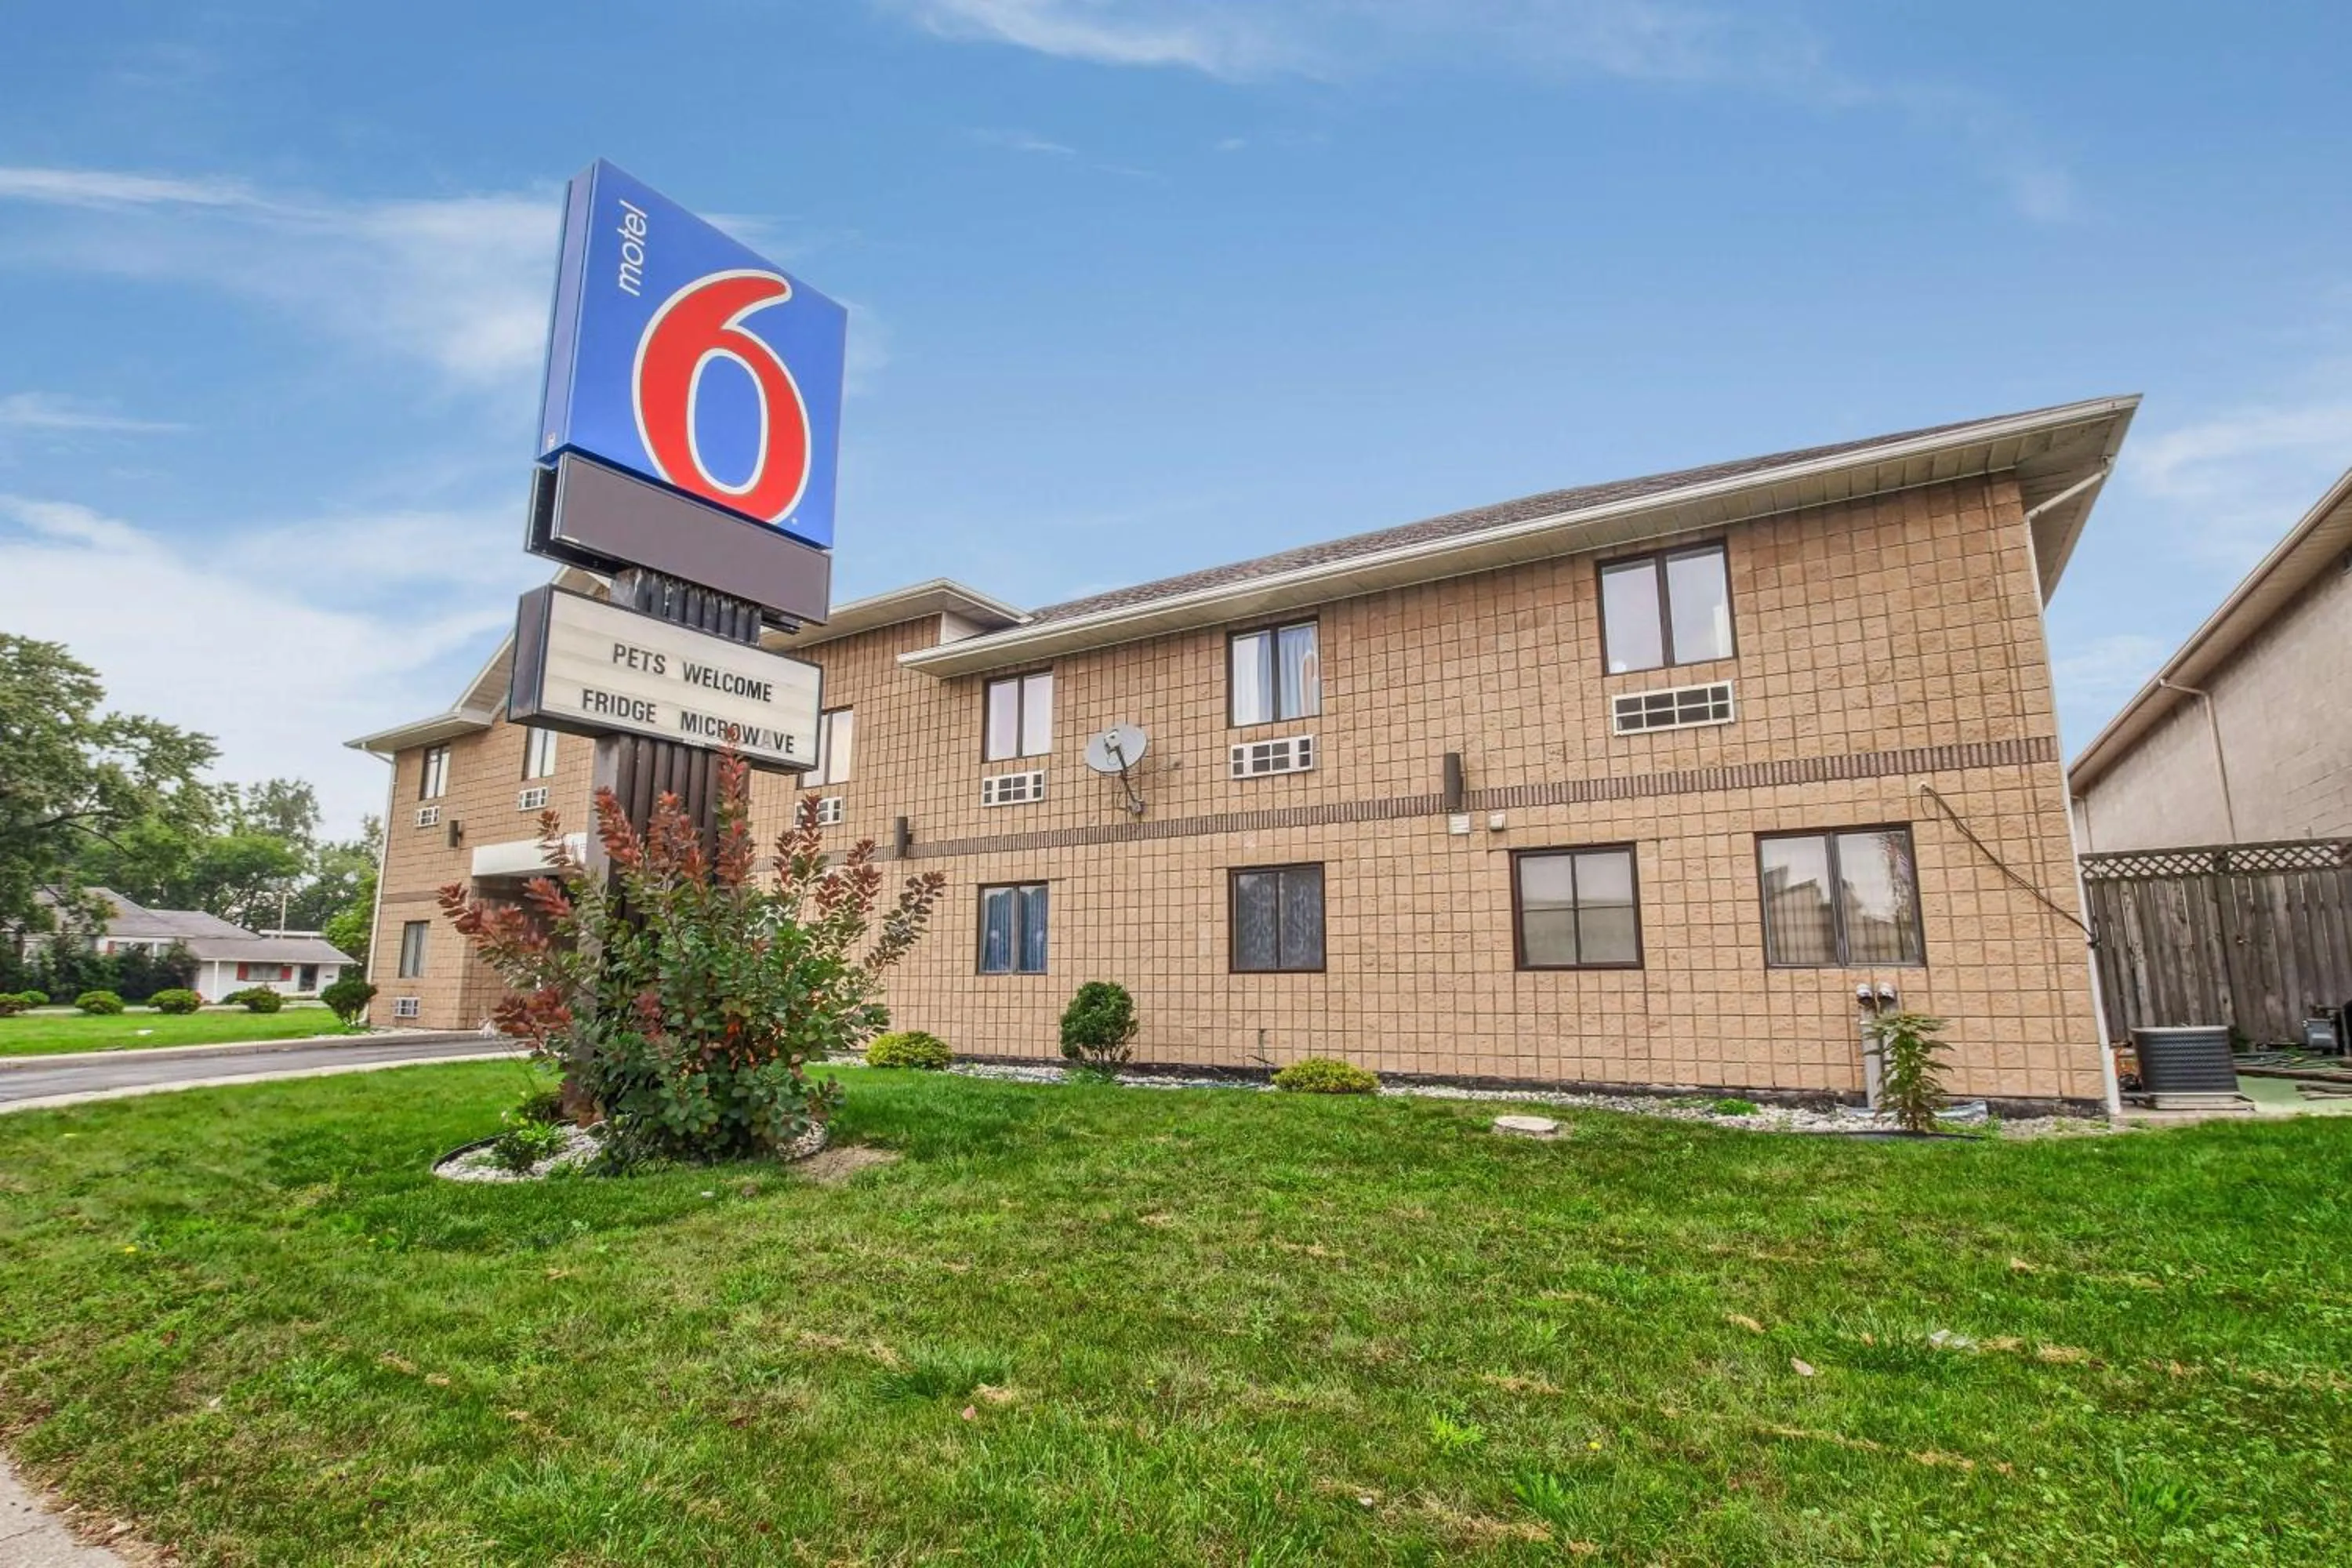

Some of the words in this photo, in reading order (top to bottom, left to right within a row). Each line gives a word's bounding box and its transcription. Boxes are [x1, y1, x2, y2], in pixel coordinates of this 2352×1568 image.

[618, 200, 648, 296] motel
[632, 269, 811, 525] 6
[583, 690, 656, 724] FRIDGE
[612, 643, 666, 675] PETS
[682, 662, 773, 702] WELCOME
